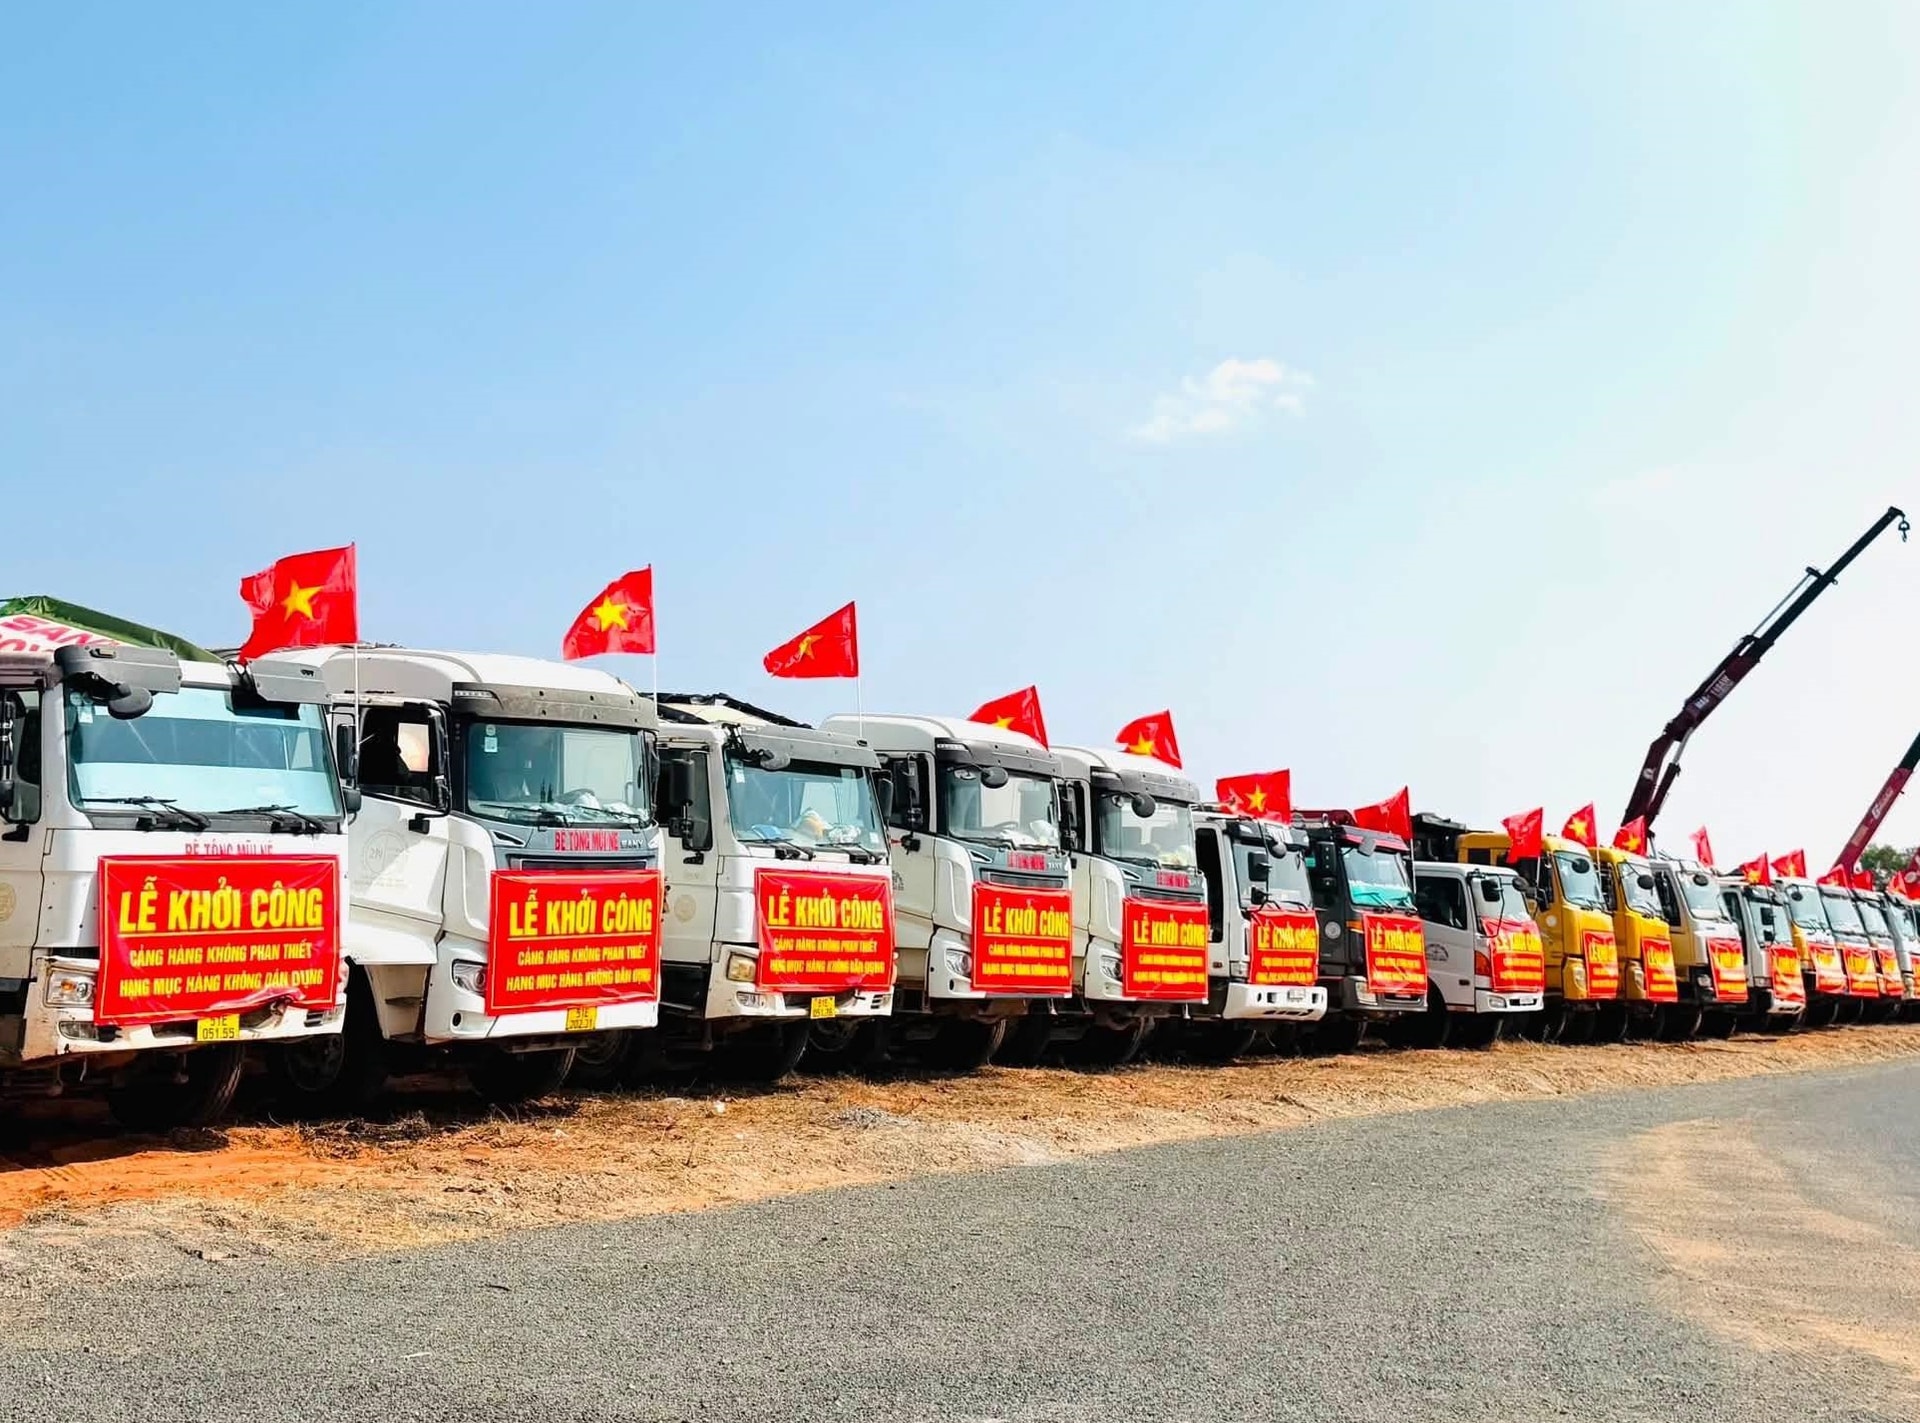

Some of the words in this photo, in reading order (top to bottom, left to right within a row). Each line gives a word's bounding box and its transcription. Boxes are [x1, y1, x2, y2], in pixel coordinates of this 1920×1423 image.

[118, 875, 158, 933] LỄ
[167, 876, 242, 931] KHỞI
[250, 880, 323, 929] CÔNG
[509, 888, 539, 937] LỄ
[546, 888, 597, 935] KHỞI
[602, 892, 653, 932] CÔNG
[768, 884, 790, 926] LỄ
[795, 887, 837, 927] KHỞI
[841, 894, 883, 929] CÔNG
[1039, 905, 1069, 937] CÔNG
[129, 943, 164, 967] CẢNG
[167, 944, 203, 965] HÀNG
[206, 941, 247, 963] KHÔNG
[250, 943, 280, 963] PHAN
[283, 937, 312, 959] THIẾT
[119, 978, 150, 1001] HẠNG
[153, 977, 182, 1000] MỤC
[186, 972, 220, 993] HÀNG
